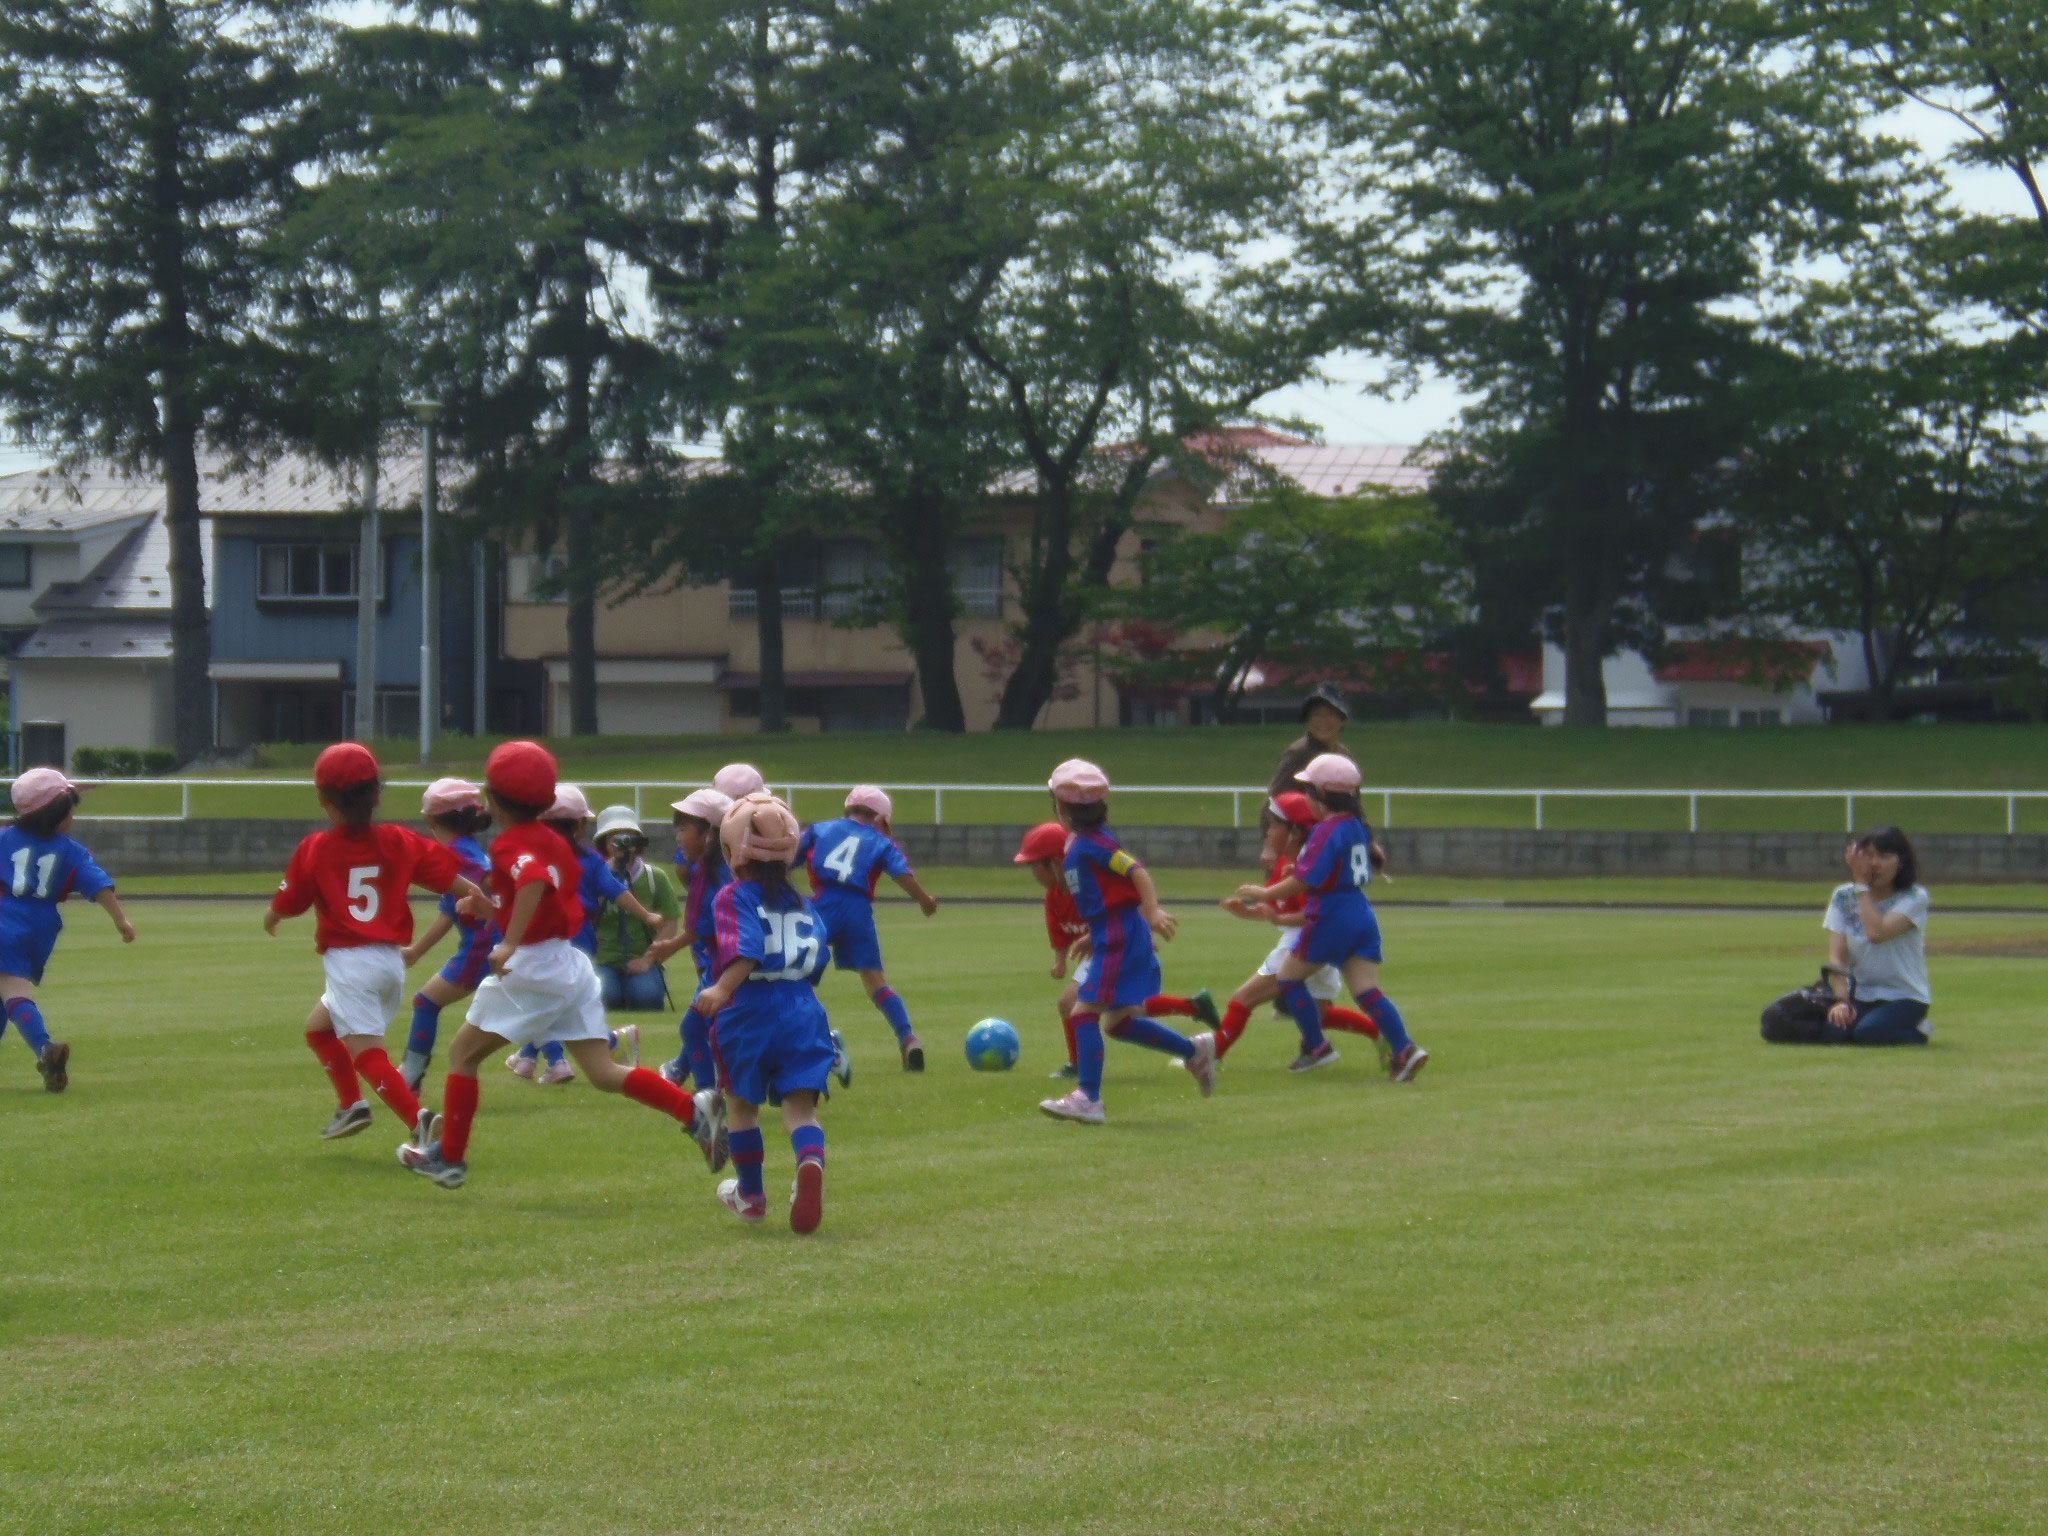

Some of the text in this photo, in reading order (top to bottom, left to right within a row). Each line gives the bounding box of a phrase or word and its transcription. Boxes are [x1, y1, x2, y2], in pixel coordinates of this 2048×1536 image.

[10, 847, 56, 898] 11
[823, 835, 860, 882] 4
[1350, 843, 1369, 887] 8
[347, 866, 379, 922] 5
